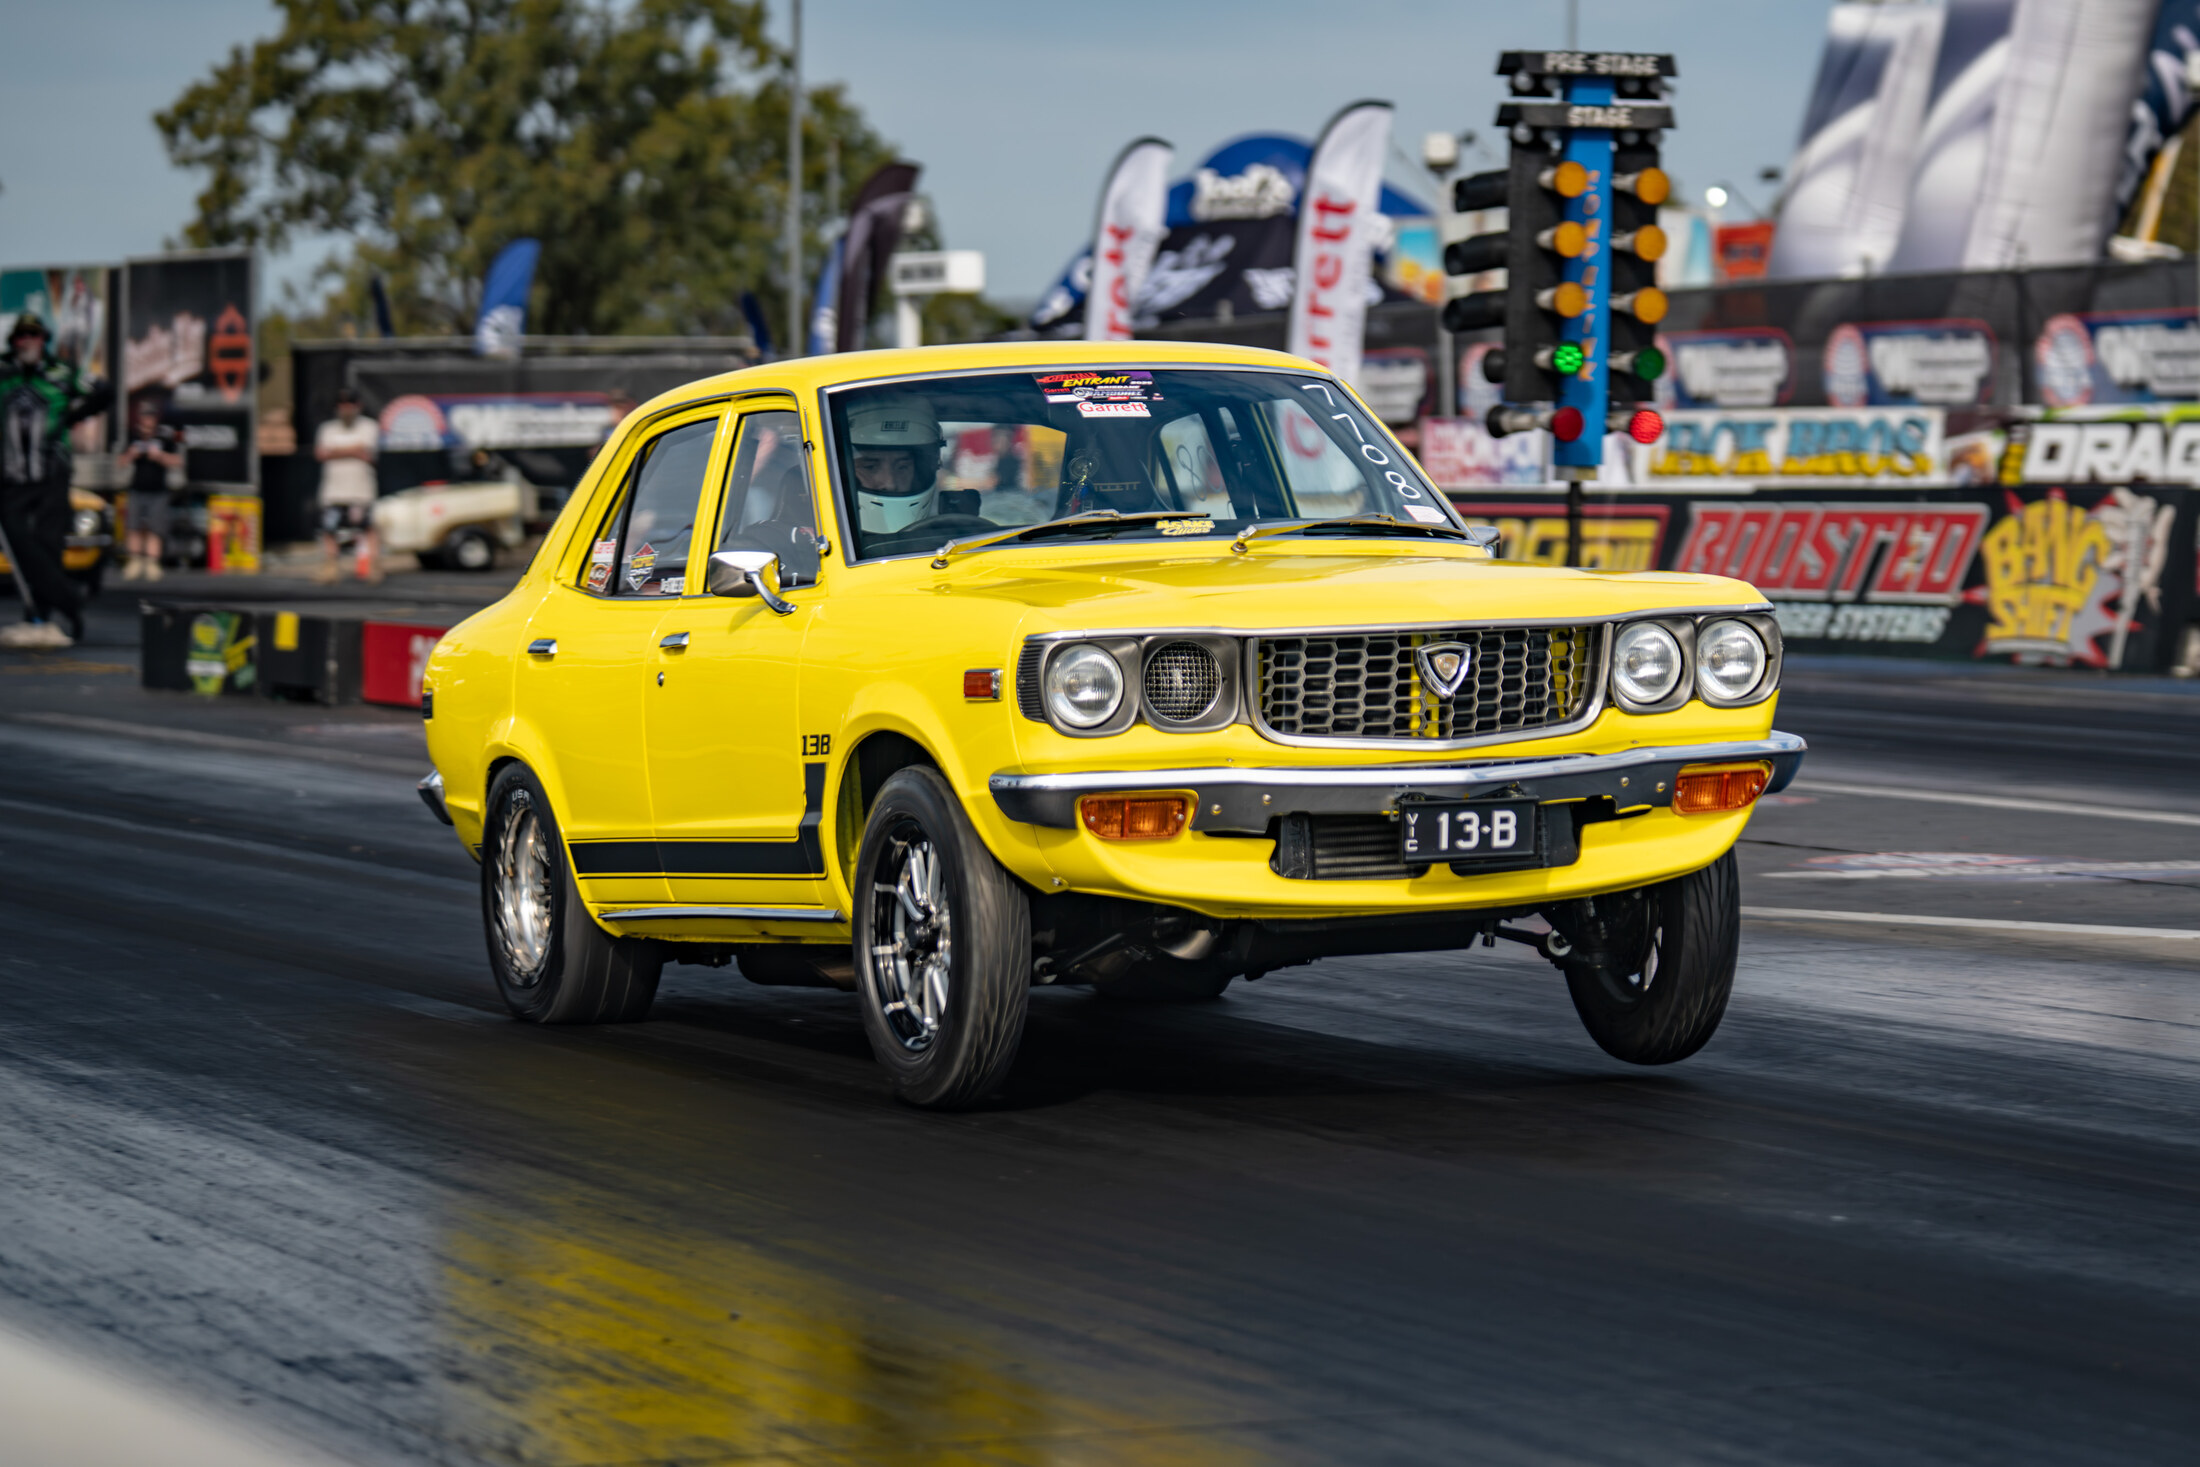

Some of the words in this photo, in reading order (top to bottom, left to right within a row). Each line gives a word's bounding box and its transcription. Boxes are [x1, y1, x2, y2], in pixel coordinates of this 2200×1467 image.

[1544, 53, 1660, 75] PRE-STAGE
[1568, 106, 1633, 127] STAGE
[1062, 375, 1131, 388] ENTRANT
[1079, 402, 1148, 413] Garrett
[1302, 384, 1421, 499] 7708
[1673, 504, 1987, 600] BOOSTED
[1826, 603, 1951, 644] SYSTEMS
[802, 734, 831, 756] 13B
[512, 789, 530, 801] USA
[1404, 812, 1419, 852] VIC
